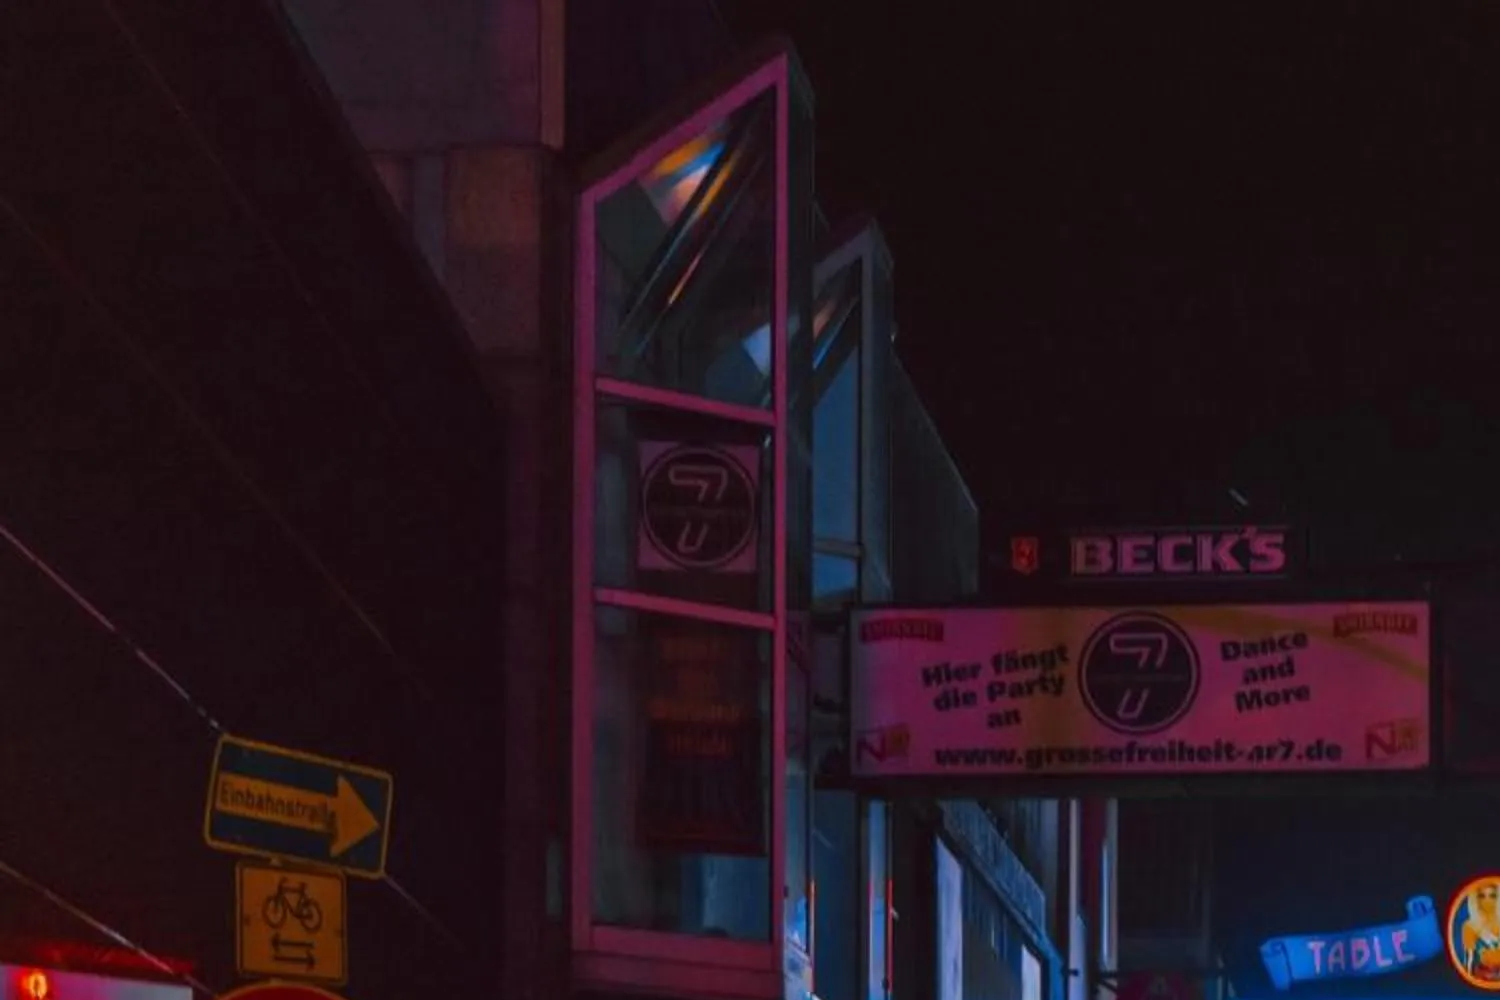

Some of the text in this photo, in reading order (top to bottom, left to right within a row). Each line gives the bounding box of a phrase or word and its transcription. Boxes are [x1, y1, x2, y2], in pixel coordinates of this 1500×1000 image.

[1070, 525, 1286, 576] BECK'S
[1220, 631, 1308, 661] Dance
[922, 645, 1069, 687] Hier fängt
[1243, 656, 1295, 685] and
[934, 673, 1065, 711] die Party
[1235, 684, 1310, 713] More
[987, 709, 1021, 729] an
[1308, 929, 1414, 973] TABLE
